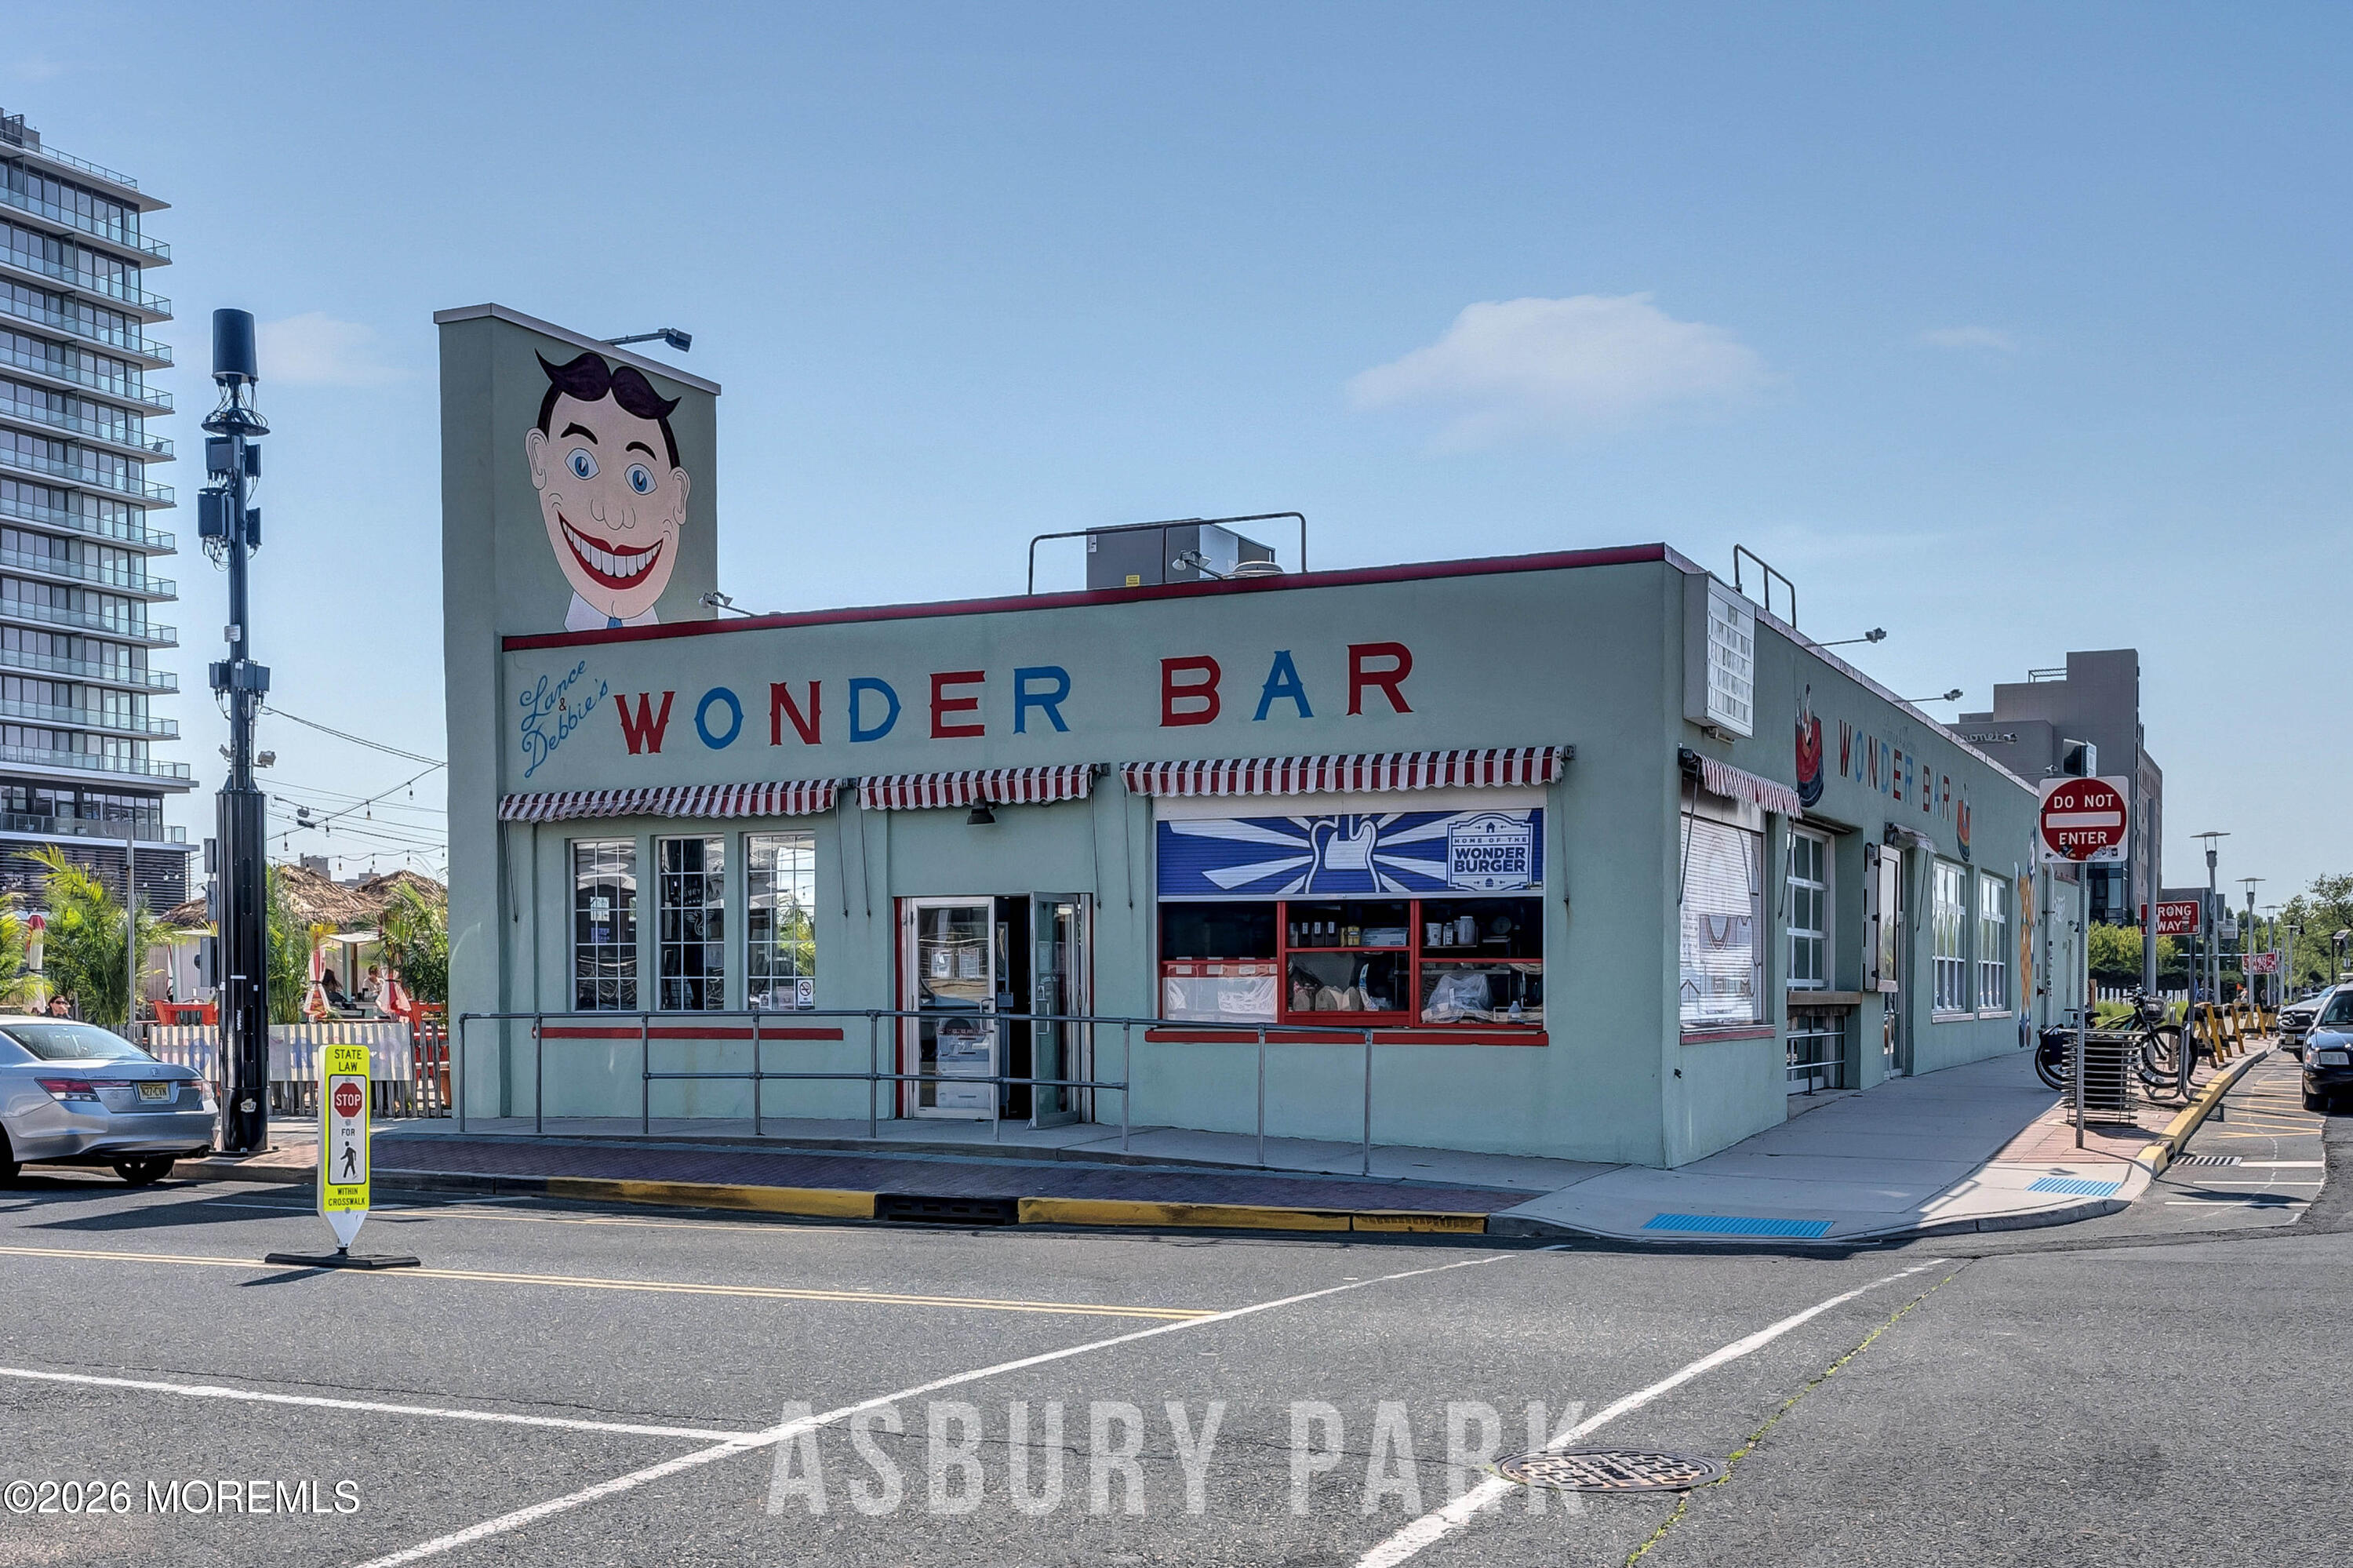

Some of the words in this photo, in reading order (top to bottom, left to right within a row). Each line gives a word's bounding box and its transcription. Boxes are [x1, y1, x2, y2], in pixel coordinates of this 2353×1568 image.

[520, 660, 587, 731] Lance
[613, 666, 1071, 755] WONDER
[1158, 642, 1414, 727] BAR
[558, 697, 566, 711] &
[522, 678, 608, 778] Debbie's
[1838, 719, 1914, 806] WONDER
[1923, 764, 1950, 822] BAR
[2053, 795, 2074, 809] DO
[2084, 794, 2114, 808] NOT
[2059, 831, 2107, 845] ENTER
[1455, 847, 1526, 859] WONDER
[1454, 859, 1526, 872] BURGER
[2157, 905, 2191, 917] RONG
[2157, 921, 2182, 932] WAY
[334, 1049, 362, 1059] STATE
[339, 1062, 358, 1071] LAW
[336, 1093, 361, 1107] STOP
[341, 1128, 355, 1137] FOR
[337, 1187, 358, 1195] WITHIN
[329, 1197, 365, 1206] CROSSWALK
